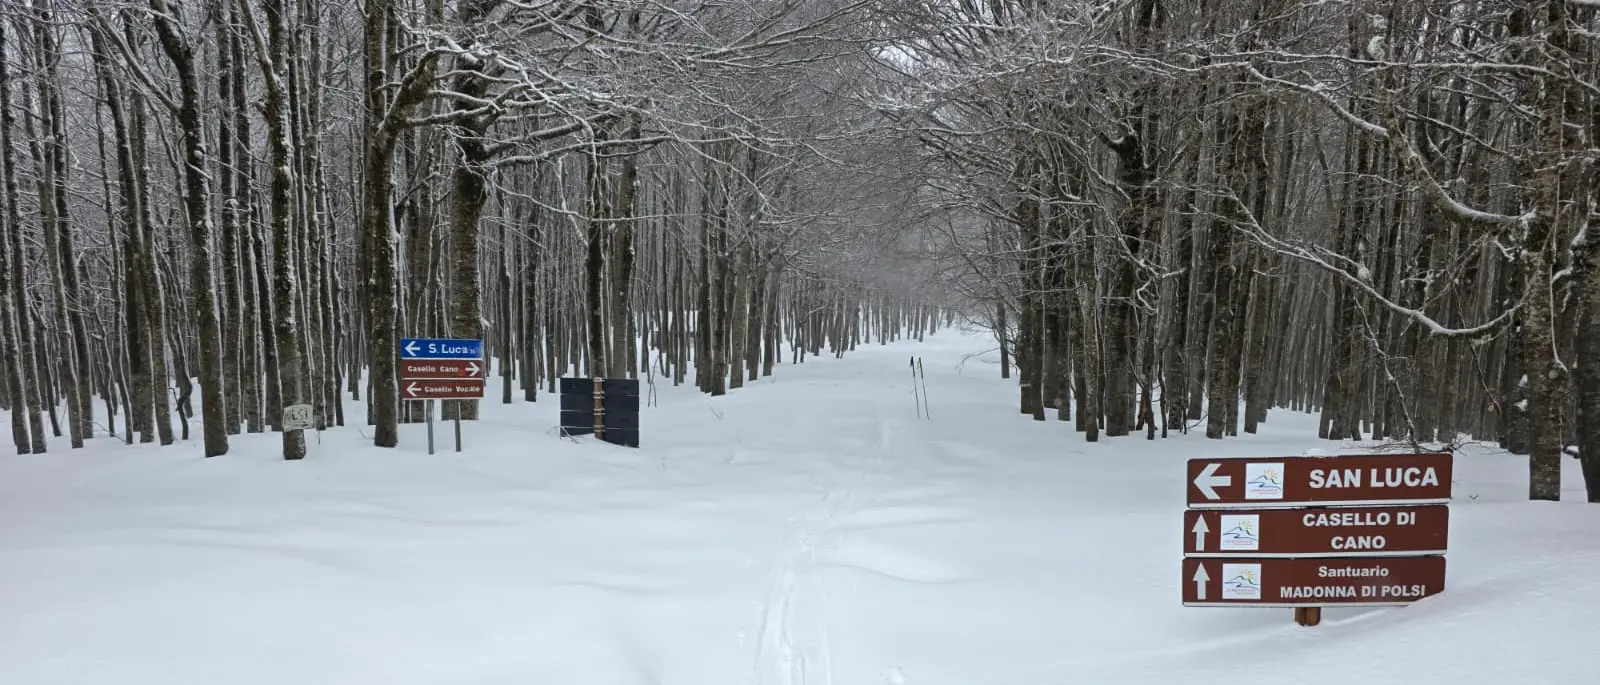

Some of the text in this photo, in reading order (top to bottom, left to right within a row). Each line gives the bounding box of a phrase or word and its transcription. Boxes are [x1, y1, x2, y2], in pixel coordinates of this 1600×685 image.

[428, 343, 440, 354] S.
[441, 343, 468, 354] Luca
[407, 365, 459, 373] Casello Cano
[1308, 467, 1440, 489] SAN LUCA
[1302, 512, 1416, 527] CASELLO DI
[1330, 535, 1386, 549] CANO
[1318, 565, 1390, 578] Santuario
[1280, 584, 1426, 599] MADONNA DI POLSI
